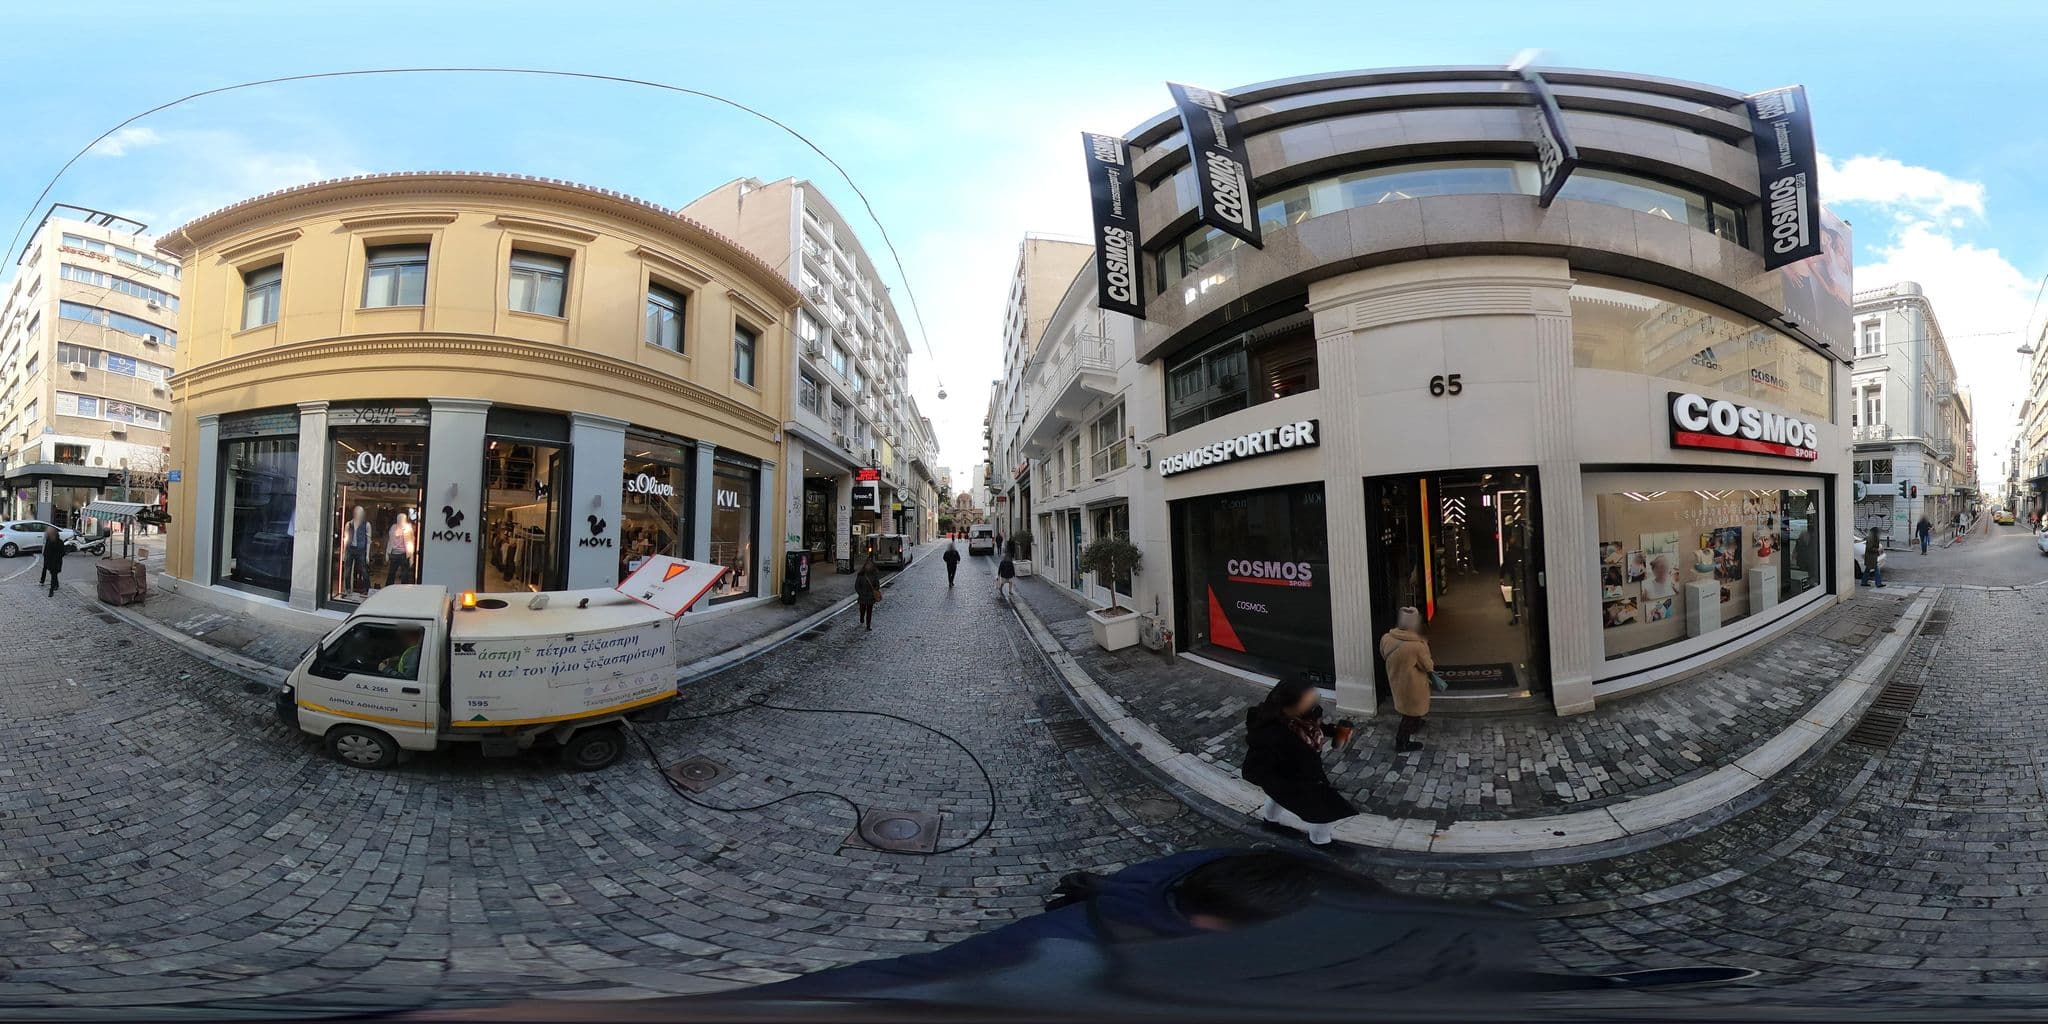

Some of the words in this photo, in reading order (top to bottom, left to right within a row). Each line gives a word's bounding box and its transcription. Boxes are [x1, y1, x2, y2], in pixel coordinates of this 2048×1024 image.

[1205, 151, 1243, 224] COSMOS
[1769, 176, 1799, 254] COSMOS
[1103, 225, 1130, 302] COSMOS
[1430, 374, 1462, 397] 65
[1750, 368, 1791, 391] COSMOS
[1673, 393, 1818, 450] COSMOS
[1159, 421, 1315, 477] COSMOSSPORT.GR
[1794, 448, 1818, 459] SPORT
[346, 451, 411, 476] s.Oliver
[627, 473, 674, 497] s.Oliver
[717, 489, 741, 508] KVL
[431, 530, 472, 543] MOVE
[579, 537, 612, 548] MOVE
[1227, 559, 1313, 580] COSMOS
[535, 643, 577, 657] πέτρα
[581, 634, 640, 653] ξέξασπρη
[478, 670, 493, 679] κι
[523, 667, 547, 677] τον
[551, 662, 580, 676] ήλιο
[583, 645, 666, 669] ξεξασπρότερη
[328, 696, 354, 706] ΔΗΜΟΣ
[357, 702, 399, 713] ΑΘΗΝΑΙΩΝ
